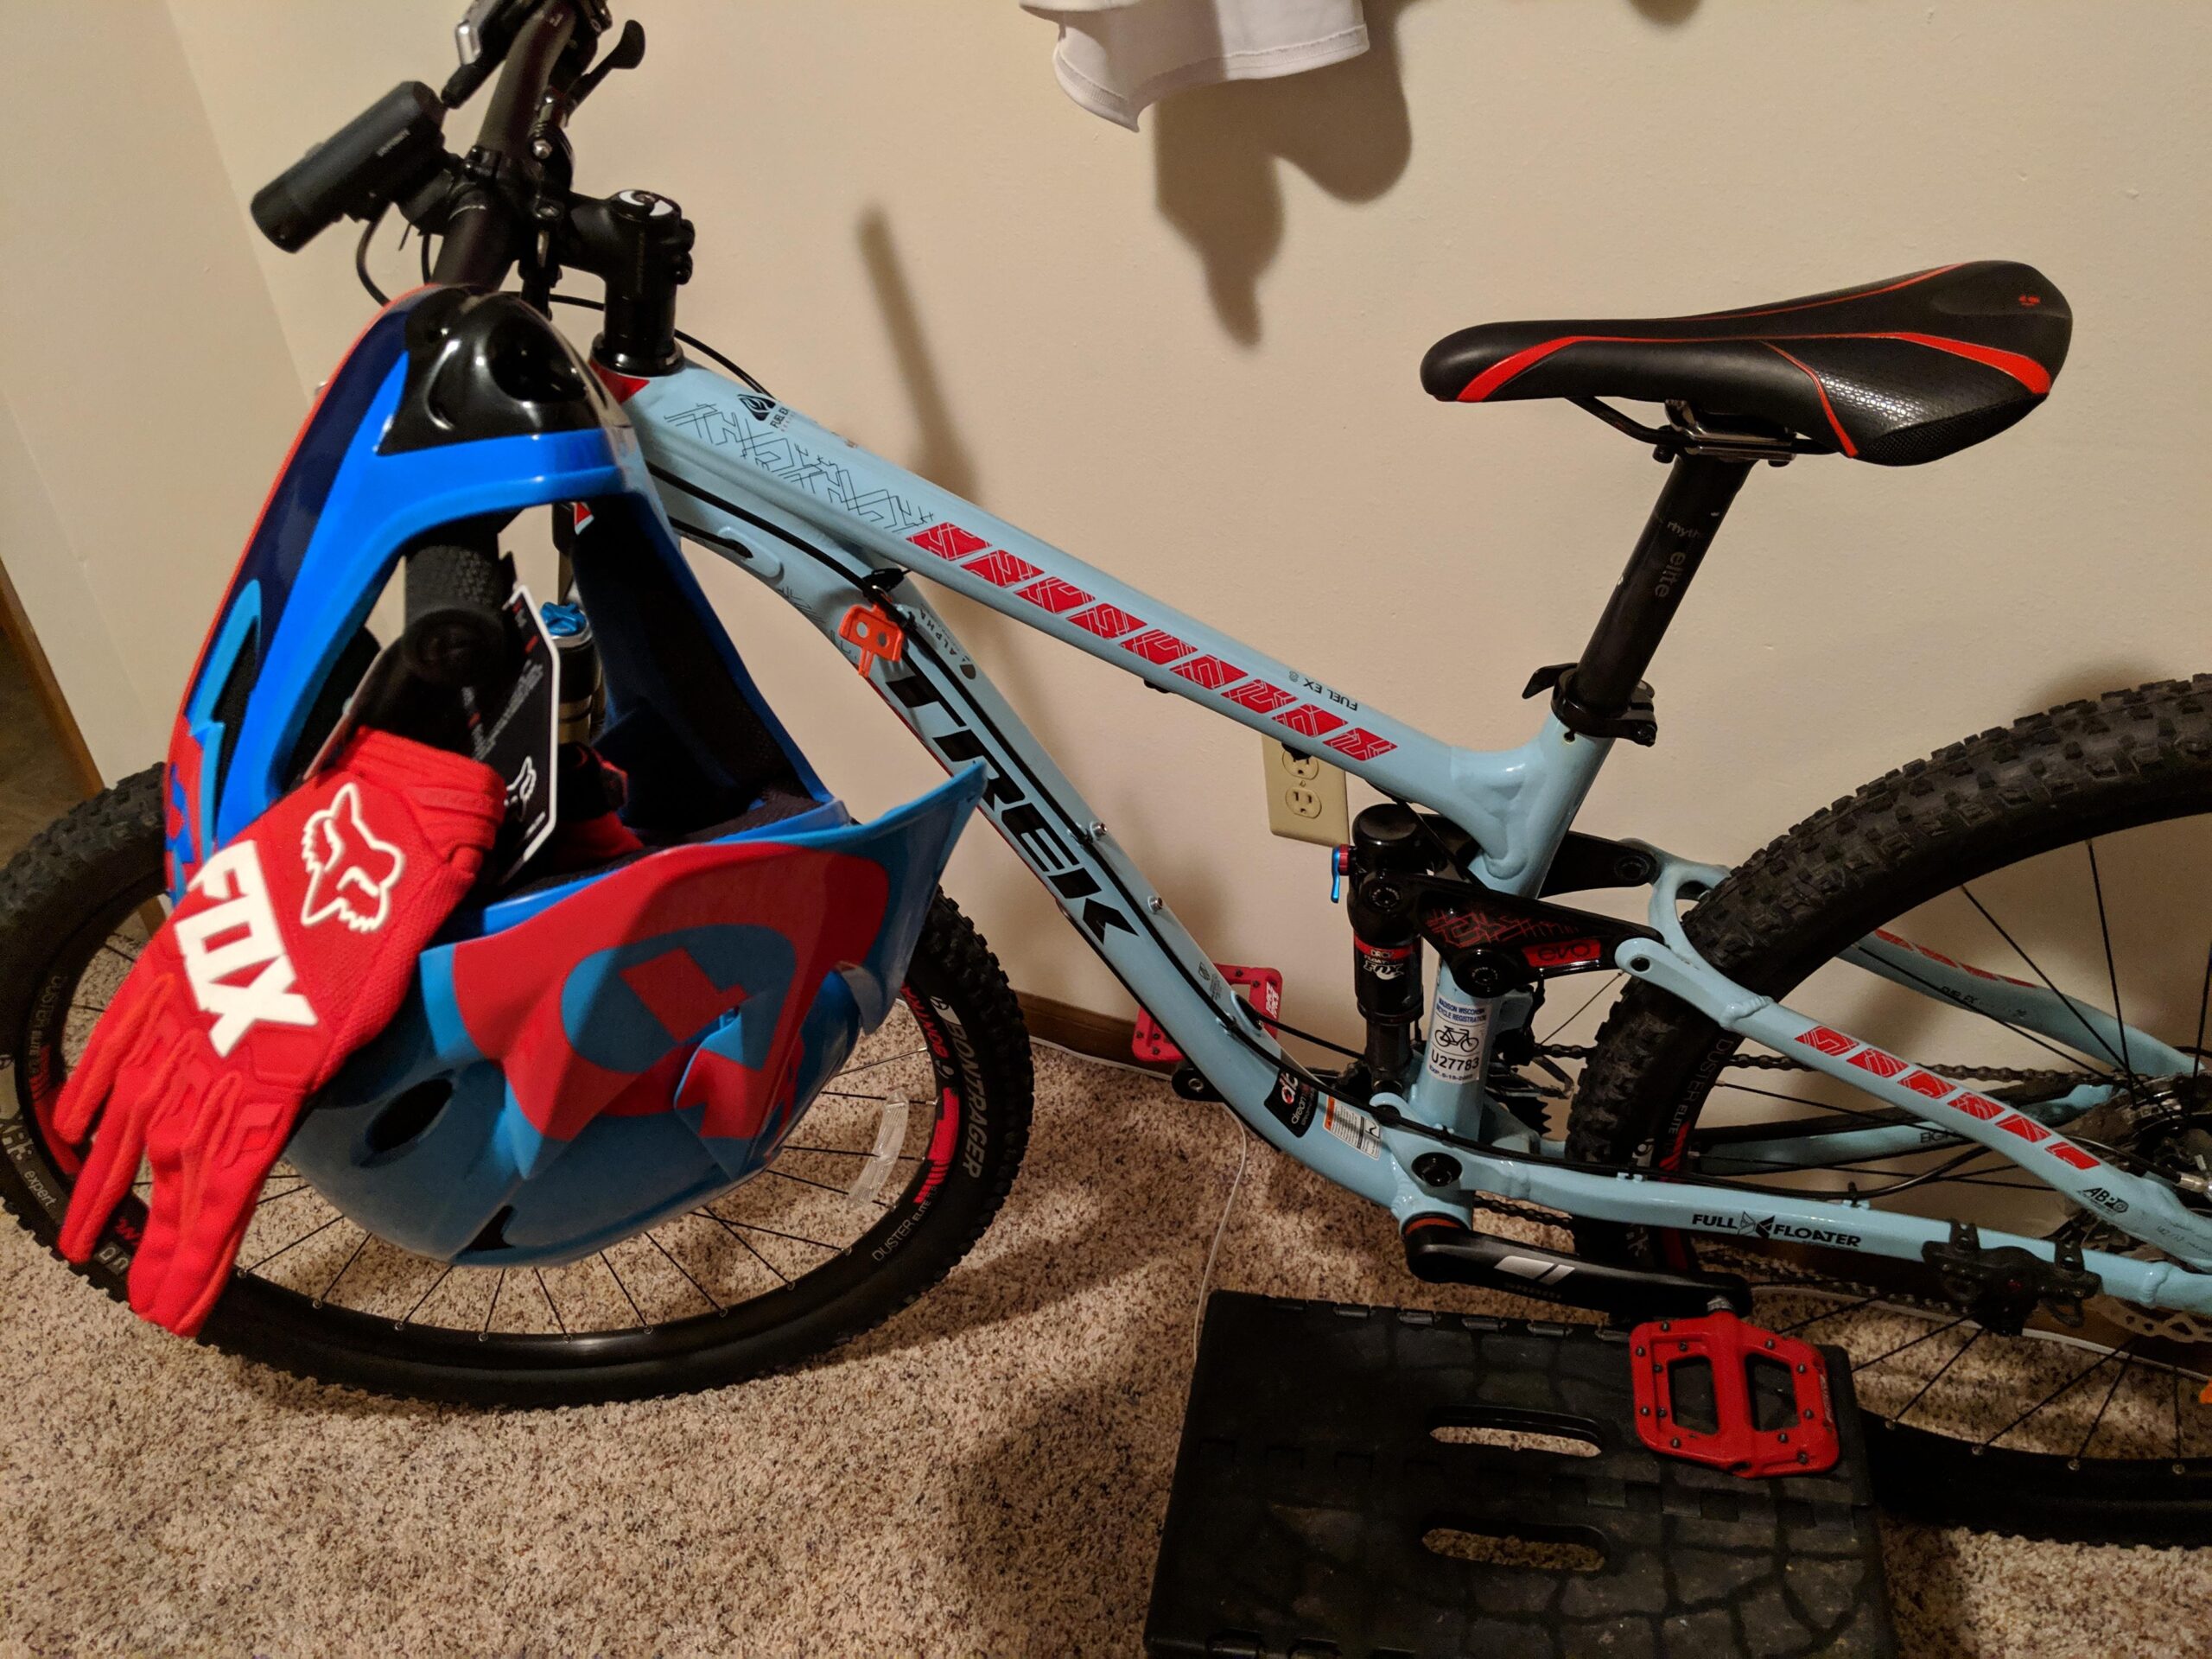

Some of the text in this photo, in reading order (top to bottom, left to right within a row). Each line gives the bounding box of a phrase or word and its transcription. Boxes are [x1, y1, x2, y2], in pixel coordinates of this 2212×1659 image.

[1655, 552, 1686, 597] elite
[919, 608, 957, 656] ALPHA
[1303, 677, 1323, 694] EX
[1327, 689, 1358, 712] FUEL
[886, 652, 1139, 945] TREK
[174, 839, 319, 1058] FOX
[1537, 943, 1590, 962] evo
[1431, 1049, 1479, 1071] U27783
[1687, 1039, 1733, 1102] DUSTER
[946, 1023, 988, 1179] BONTRAGER
[1669, 1104, 1688, 1134] ELITE
[24, 1169, 57, 1208] expert
[872, 1218, 915, 1262] DUSTER
[912, 1199, 932, 1222] ELITE
[1692, 1214, 1862, 1247] FULL FLOATER
